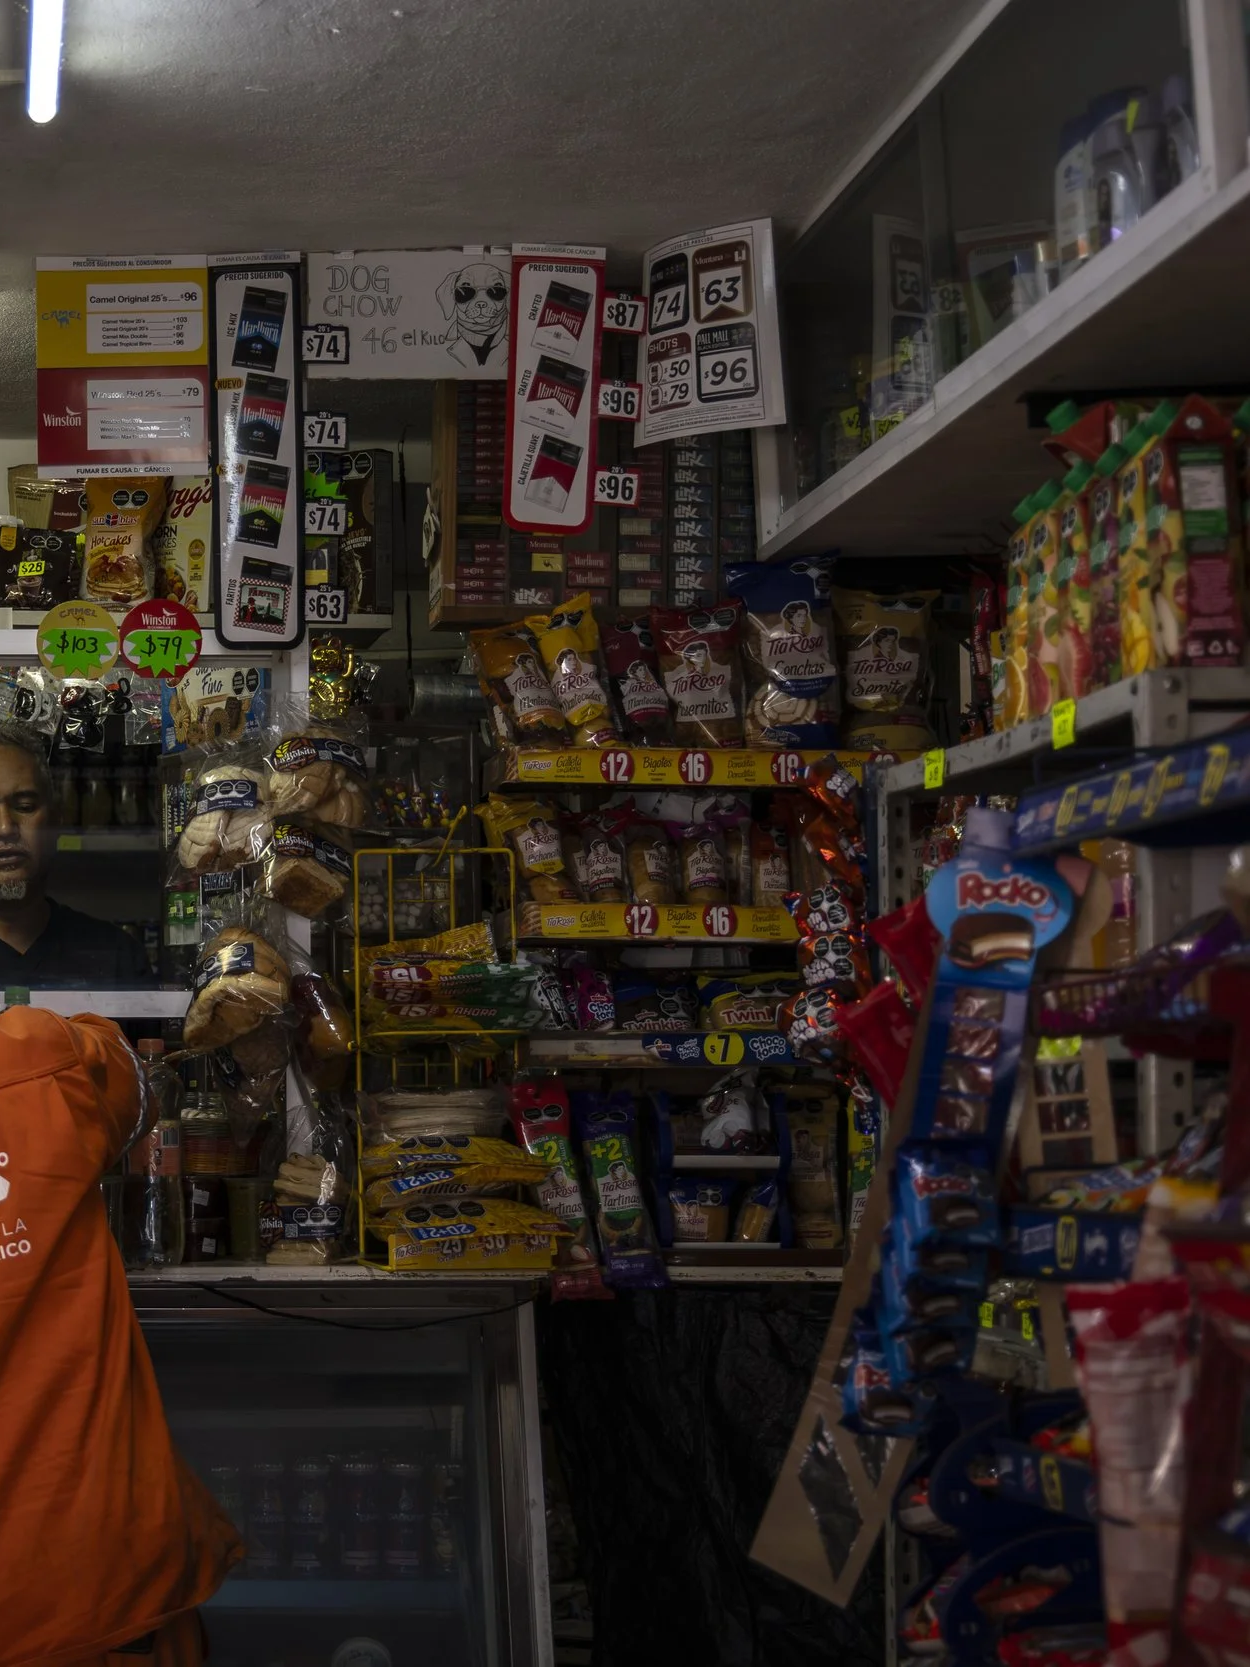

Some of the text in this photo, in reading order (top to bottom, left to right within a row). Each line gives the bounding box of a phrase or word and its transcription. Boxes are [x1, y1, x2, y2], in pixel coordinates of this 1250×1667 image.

[528, 264, 589, 274] PRECIO SUGERIDO
[694, 253, 724, 266] Montana
[224, 272, 284, 281] PRECIO SUGERIDO
[325, 264, 390, 294] DOG
[89, 291, 198, 305] Camel Original $96
[701, 275, 741, 306] $63
[41, 310, 82, 322] CAMEL
[322, 294, 403, 318] CHOW
[528, 294, 543, 322] CRAFTED
[607, 302, 639, 328] $87
[654, 291, 681, 323] $74
[226, 312, 238, 338] ICE MIX
[241, 319, 280, 344] Marlboro
[545, 307, 581, 335] Marlboro
[306, 334, 340, 359] $74
[361, 327, 417, 354] 46 el
[649, 338, 678, 354] SHOTS
[697, 329, 730, 346] PALL MALL
[664, 358, 690, 378] $50
[703, 357, 748, 386] $96
[182, 387, 199, 397] $79
[217, 378, 243, 390] NUEVO
[518, 369, 532, 397] CRAFTED
[537, 381, 574, 410] Marlboro
[664, 383, 689, 402] $79
[232, 392, 241, 405] MIX
[602, 388, 635, 415] $96
[43, 413, 82, 428] Winston
[242, 406, 282, 431] Marlboro
[308, 420, 341, 445] $74
[144, 465, 171, 473] CÁNCER
[517, 434, 540, 485] CAJETILLA SUAVE
[598, 475, 634, 501] $96
[244, 494, 284, 522] Marlboro
[308, 507, 340, 532] $74
[20, 562, 43, 575] $28
[574, 555, 604, 567] Marlboro
[575, 573, 605, 585] Marlboro
[225, 578, 237, 606] FARITOS
[58, 606, 98, 619] CAMEL
[141, 611, 177, 626] Winston
[308, 594, 341, 619] $63
[56, 630, 99, 654] $103
[140, 635, 183, 660] $79
[774, 660, 826, 676] Conchas
[201, 673, 224, 696] Fino
[676, 697, 729, 718] Cuernitos
[601, 752, 629, 782] $12
[642, 753, 706, 783] Bigotes $16
[772, 754, 800, 784] $18
[956, 872, 1049, 909] Rocko
[626, 905, 653, 934] $12
[667, 906, 730, 936] Bigotes $16
[454, 1007, 498, 1017] AHORA
[623, 1018, 692, 1032] Twinkies
[709, 1034, 731, 1063] $7
[749, 1035, 786, 1049] Choco
[602, 1193, 642, 1208] Tartinas
[1, 1217, 28, 1238] LA
